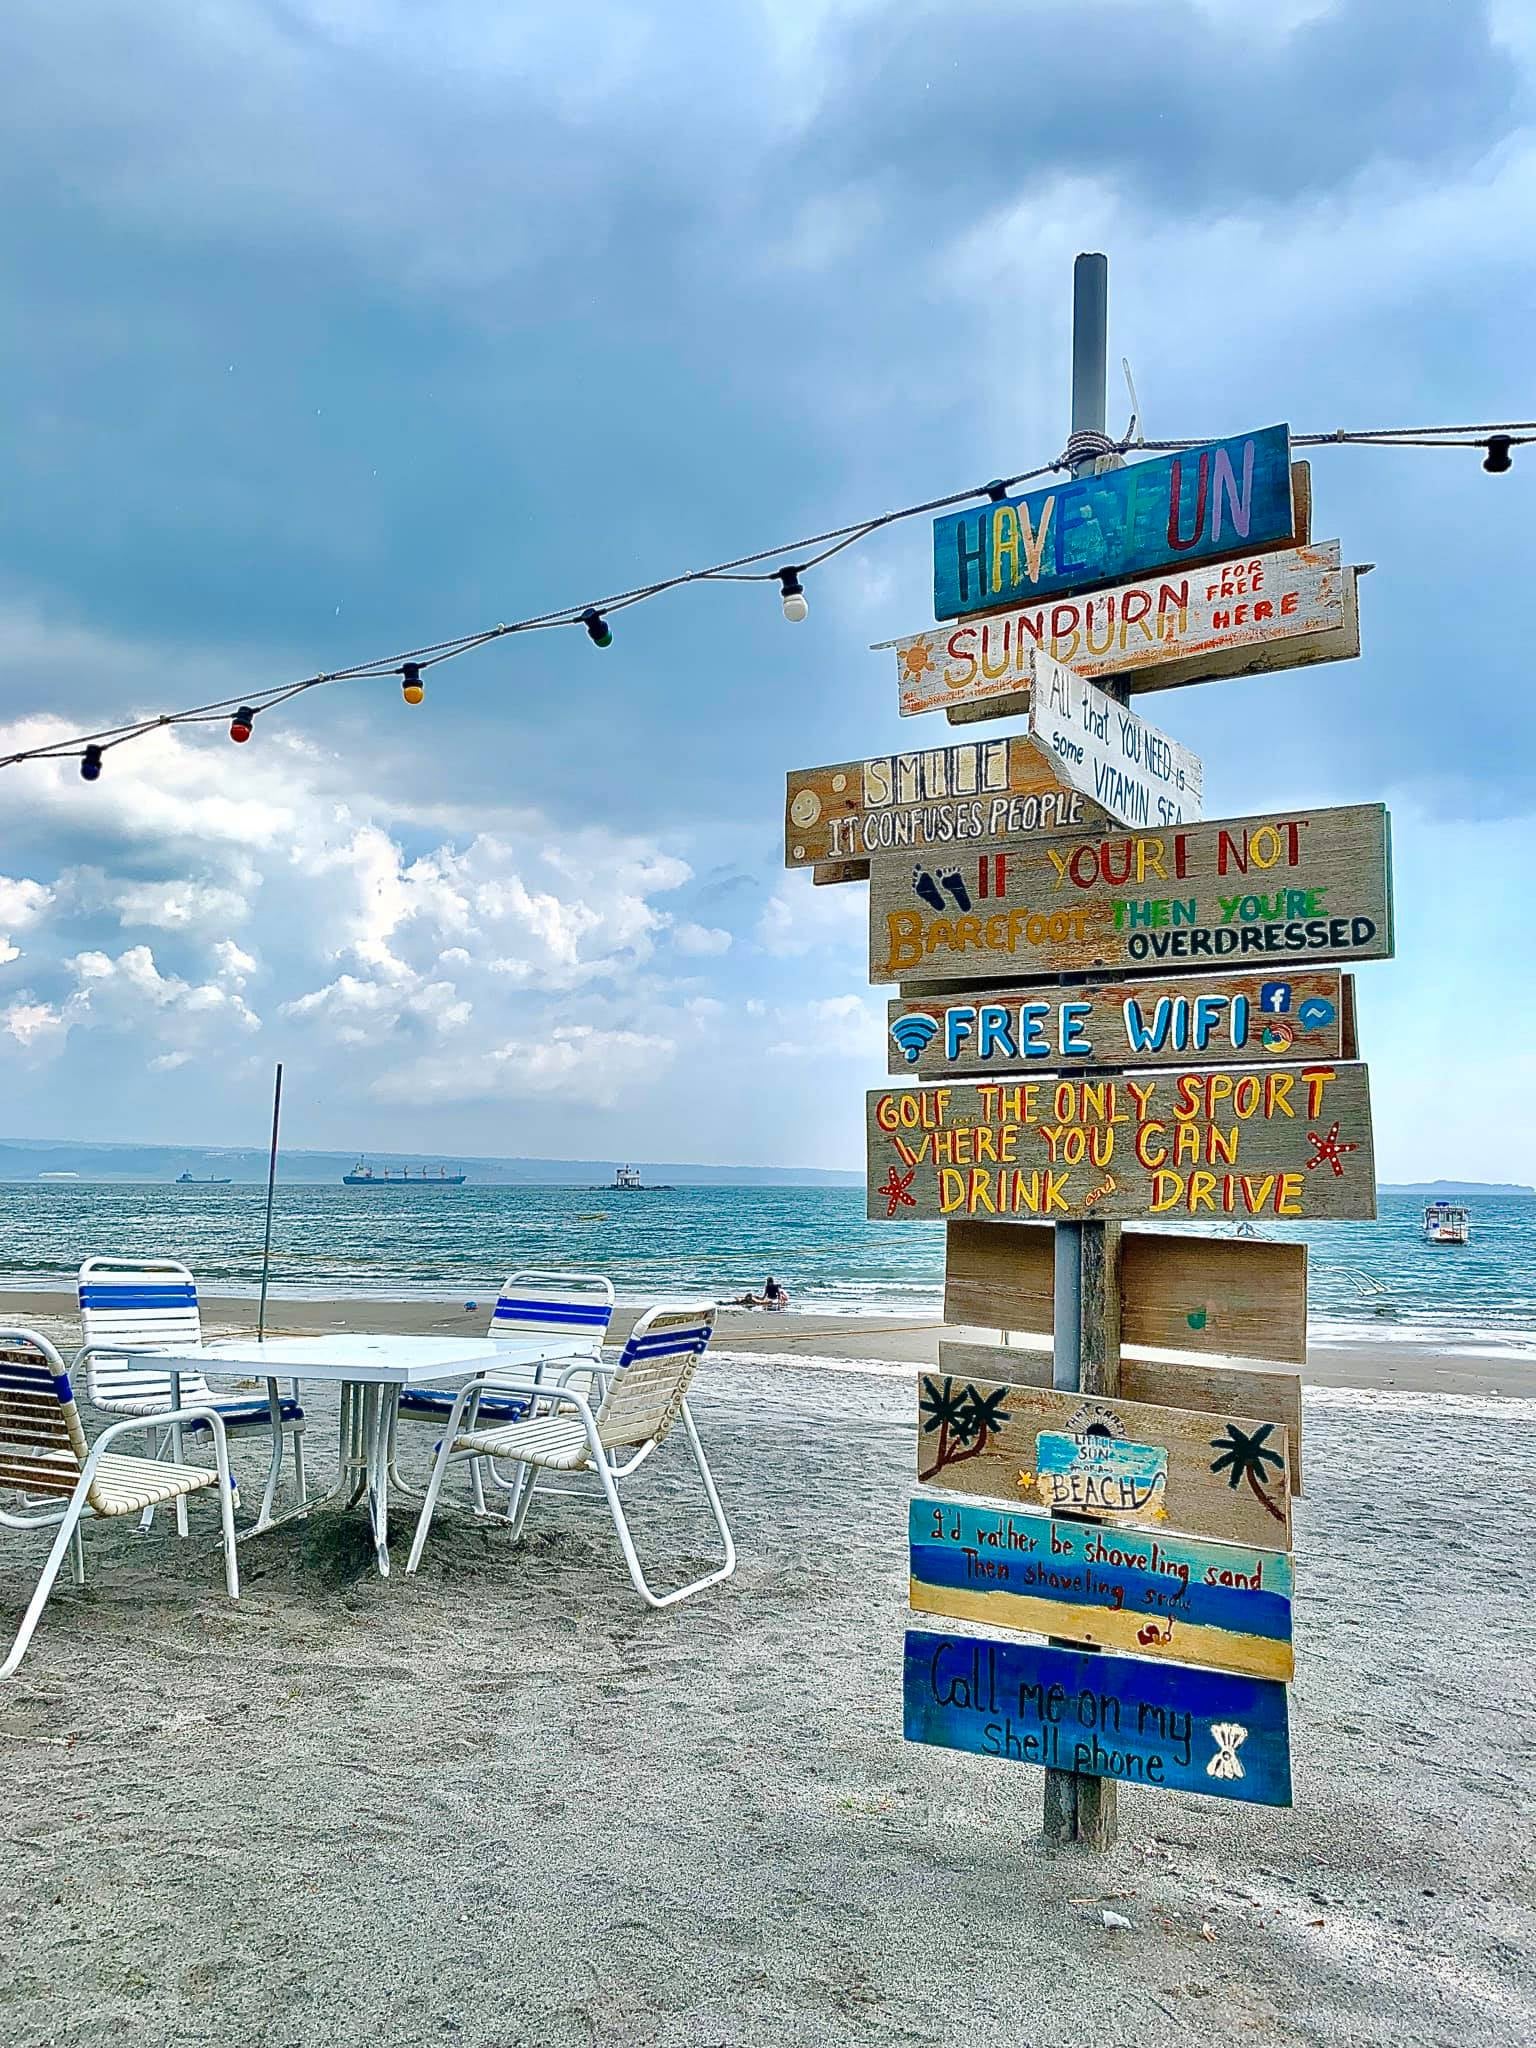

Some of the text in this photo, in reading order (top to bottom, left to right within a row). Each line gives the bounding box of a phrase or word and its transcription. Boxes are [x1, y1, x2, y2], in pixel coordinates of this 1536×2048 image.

[957, 440, 1255, 602] HAVE FUN
[1206, 574, 1264, 600] FREE
[1221, 559, 1262, 580] FOR
[943, 580, 1189, 689] SUNBURN
[1213, 593, 1298, 629] HERE
[1082, 686, 1110, 745] that
[1118, 712, 1141, 763] YOU
[1145, 730, 1171, 781] NEED
[865, 741, 1009, 807] SMILE
[1053, 731, 1182, 826] some VITAMIN SEA
[828, 793, 1085, 857] IT CONFUSES PEOPLE
[979, 852, 1019, 898] IF
[1217, 821, 1310, 875] NOT
[1110, 887, 1330, 929] THEN YOU'RE
[1128, 916, 1376, 960] OVERDRESSED
[945, 994, 1249, 1061] FREE WIFI
[976, 1083, 1040, 1124] THE
[1055, 1081, 1156, 1125] ONLY
[1174, 1066, 1337, 1121] SPORT
[893, 1120, 1239, 1171] WHERE YOU CAN
[937, 1168, 1305, 1214] DRINK and DRIVE
[1079, 1447, 1109, 1459] SUN
[1052, 1474, 1140, 1506] BEACH
[961, 1547, 1009, 1580] Then
[1023, 1562, 1125, 1611] shoveling
[977, 1519, 1039, 1553] rather
[1051, 1523, 1073, 1555] be
[1084, 1534, 1188, 1598] shoveling
[1204, 1561, 1262, 1591] sand
[930, 1642, 999, 1714] Call
[1078, 1690, 1120, 1733] on
[1138, 1703, 1192, 1766] my
[1074, 1734, 1166, 1783] phone
